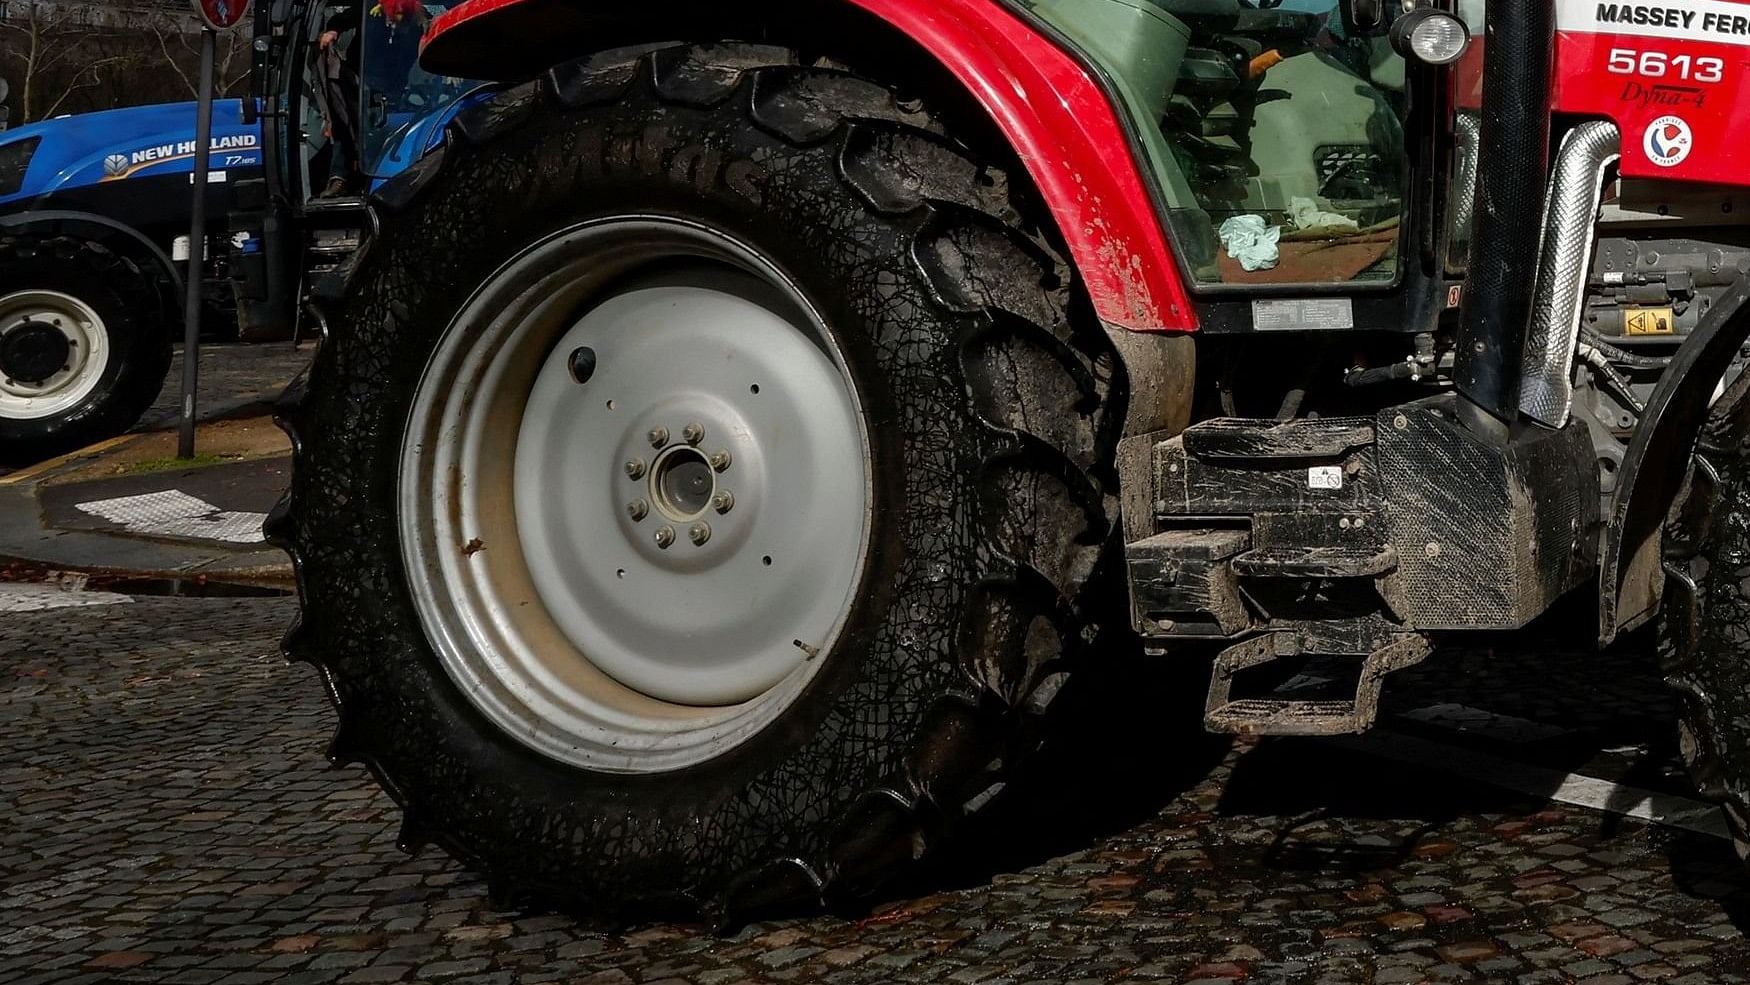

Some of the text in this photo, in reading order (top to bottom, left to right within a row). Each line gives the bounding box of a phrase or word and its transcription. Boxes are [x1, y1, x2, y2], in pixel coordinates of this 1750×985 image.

[1596, 3, 1696, 29] MASSEY
[1607, 48, 1725, 84] 5613
[1620, 81, 1707, 109] Dyna-4
[131, 135, 257, 165] NEW HLAND
